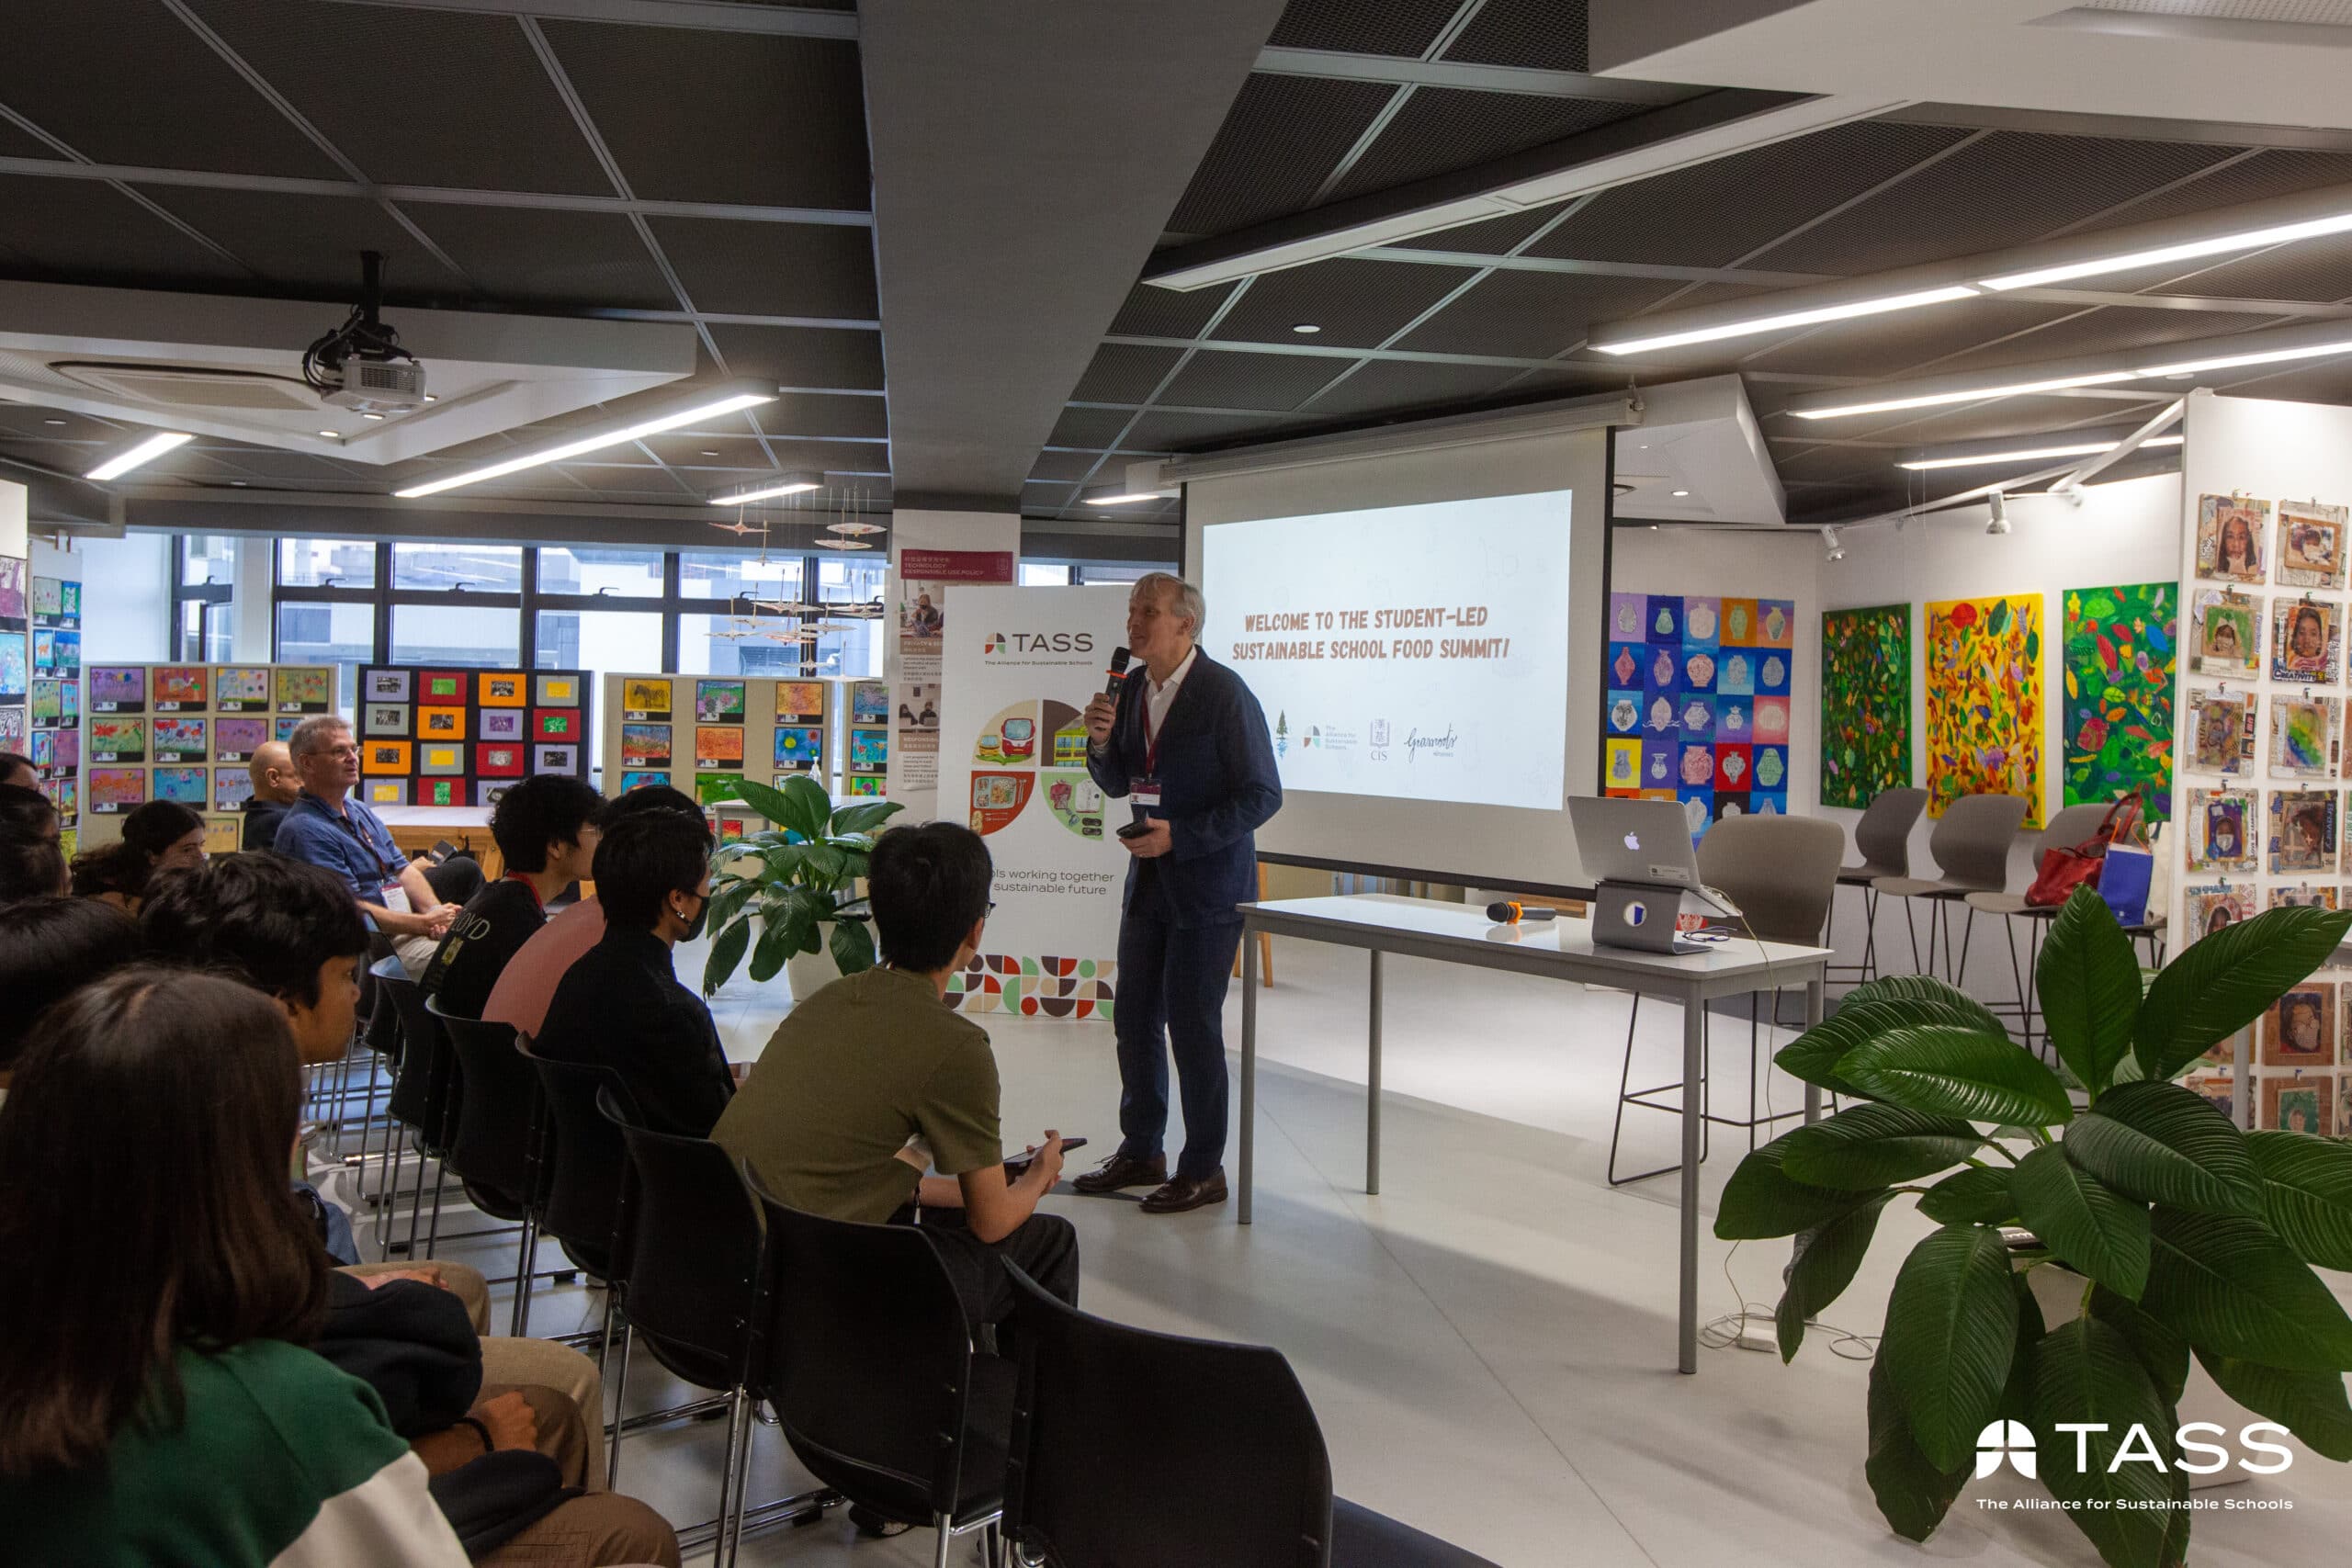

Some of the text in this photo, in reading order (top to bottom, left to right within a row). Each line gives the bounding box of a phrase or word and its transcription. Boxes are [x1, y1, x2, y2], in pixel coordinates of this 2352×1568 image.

[1245, 606, 1488, 632] WELCOME TO THE STUDENT-LED
[1012, 633, 1093, 652] TASS
[1232, 641, 1325, 660] SUSTAINABLE
[1329, 640, 1386, 659] SCHOOL
[1393, 639, 1433, 659] FOOD
[1371, 750, 1387, 761] CIS
[1009, 870, 1057, 882] working
[1060, 871, 1114, 884] together
[993, 883, 1106, 896] sustainable future
